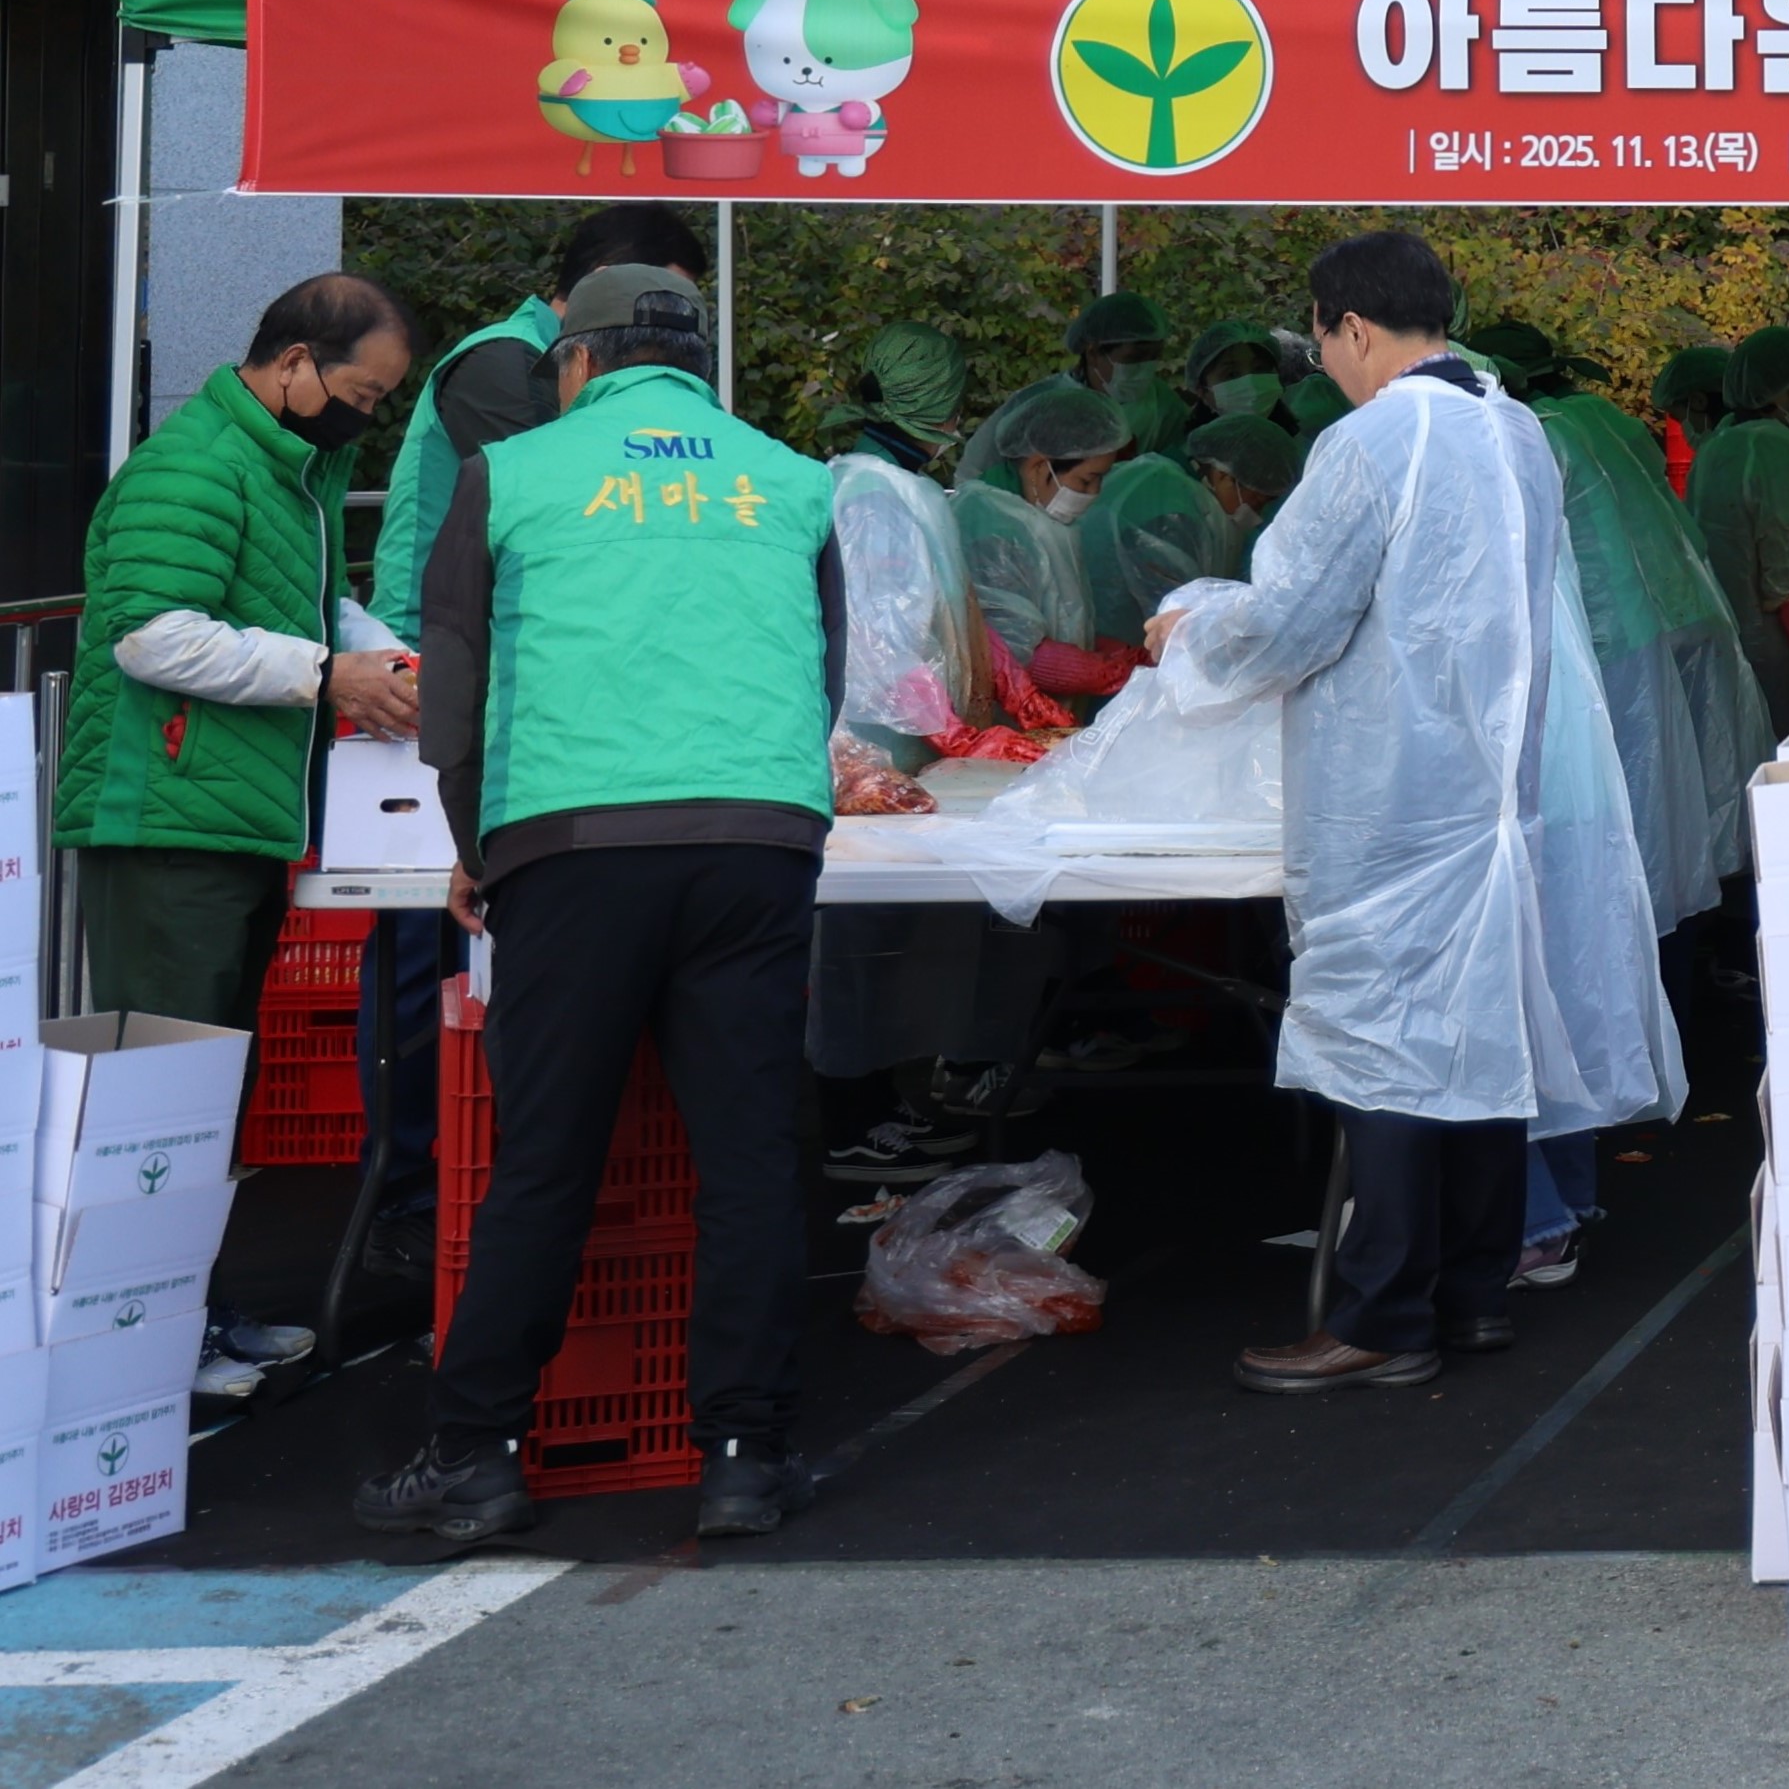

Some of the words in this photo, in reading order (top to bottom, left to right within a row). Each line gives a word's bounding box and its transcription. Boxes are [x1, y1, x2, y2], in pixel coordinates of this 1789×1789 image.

[1430, 132, 1490, 170] 일시
[1521, 135, 1599, 167] 2025.
[1613, 136, 1651, 167] 11.
[1664, 133, 1757, 171] 13.(목)
[623, 434, 715, 460] SMU
[583, 471, 767, 527] 새마을
[49, 1488, 101, 1522] 사랑의
[107, 1467, 173, 1509] 김장김치
